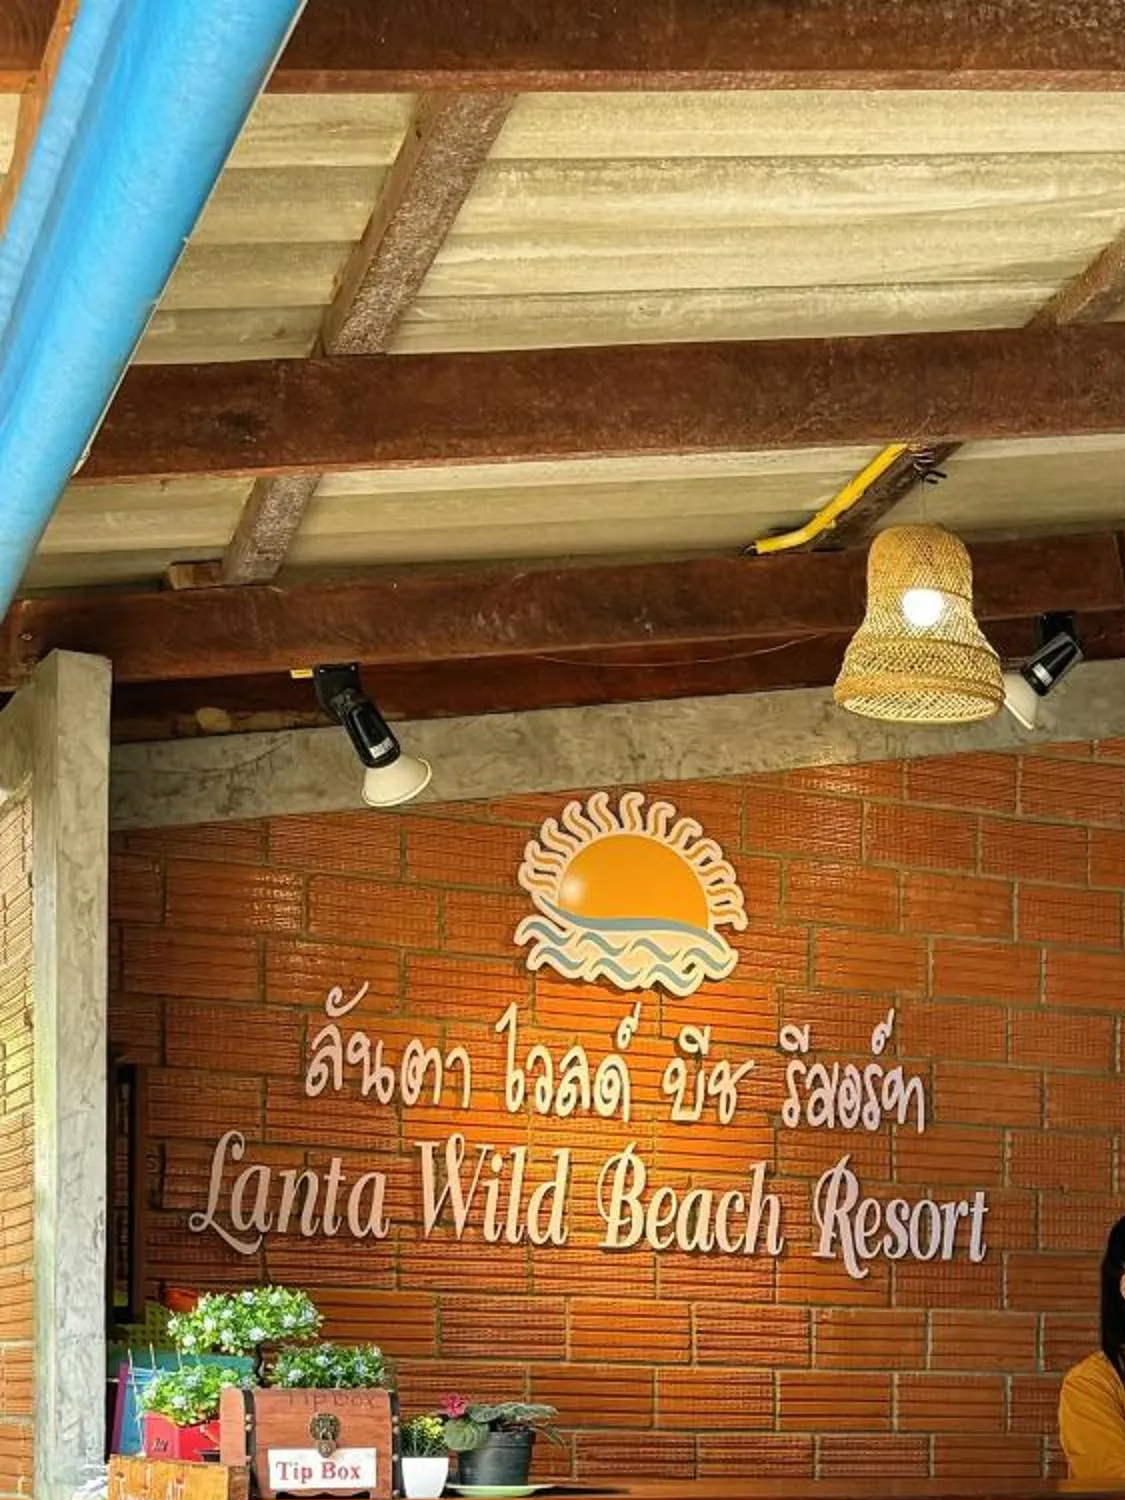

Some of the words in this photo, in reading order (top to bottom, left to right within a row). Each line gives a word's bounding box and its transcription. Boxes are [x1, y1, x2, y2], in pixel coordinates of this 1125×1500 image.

[306, 981, 472, 1110] ลันตา
[662, 1024, 755, 1124] บีช
[779, 1008, 925, 1135] รีสอร์ท
[189, 1130, 389, 1255] Lanta
[412, 1132, 569, 1247] Wild
[597, 1141, 784, 1256] Beach
[811, 1155, 989, 1279] Resort
[275, 1460, 313, 1484] Tip
[321, 1460, 361, 1480] Box
